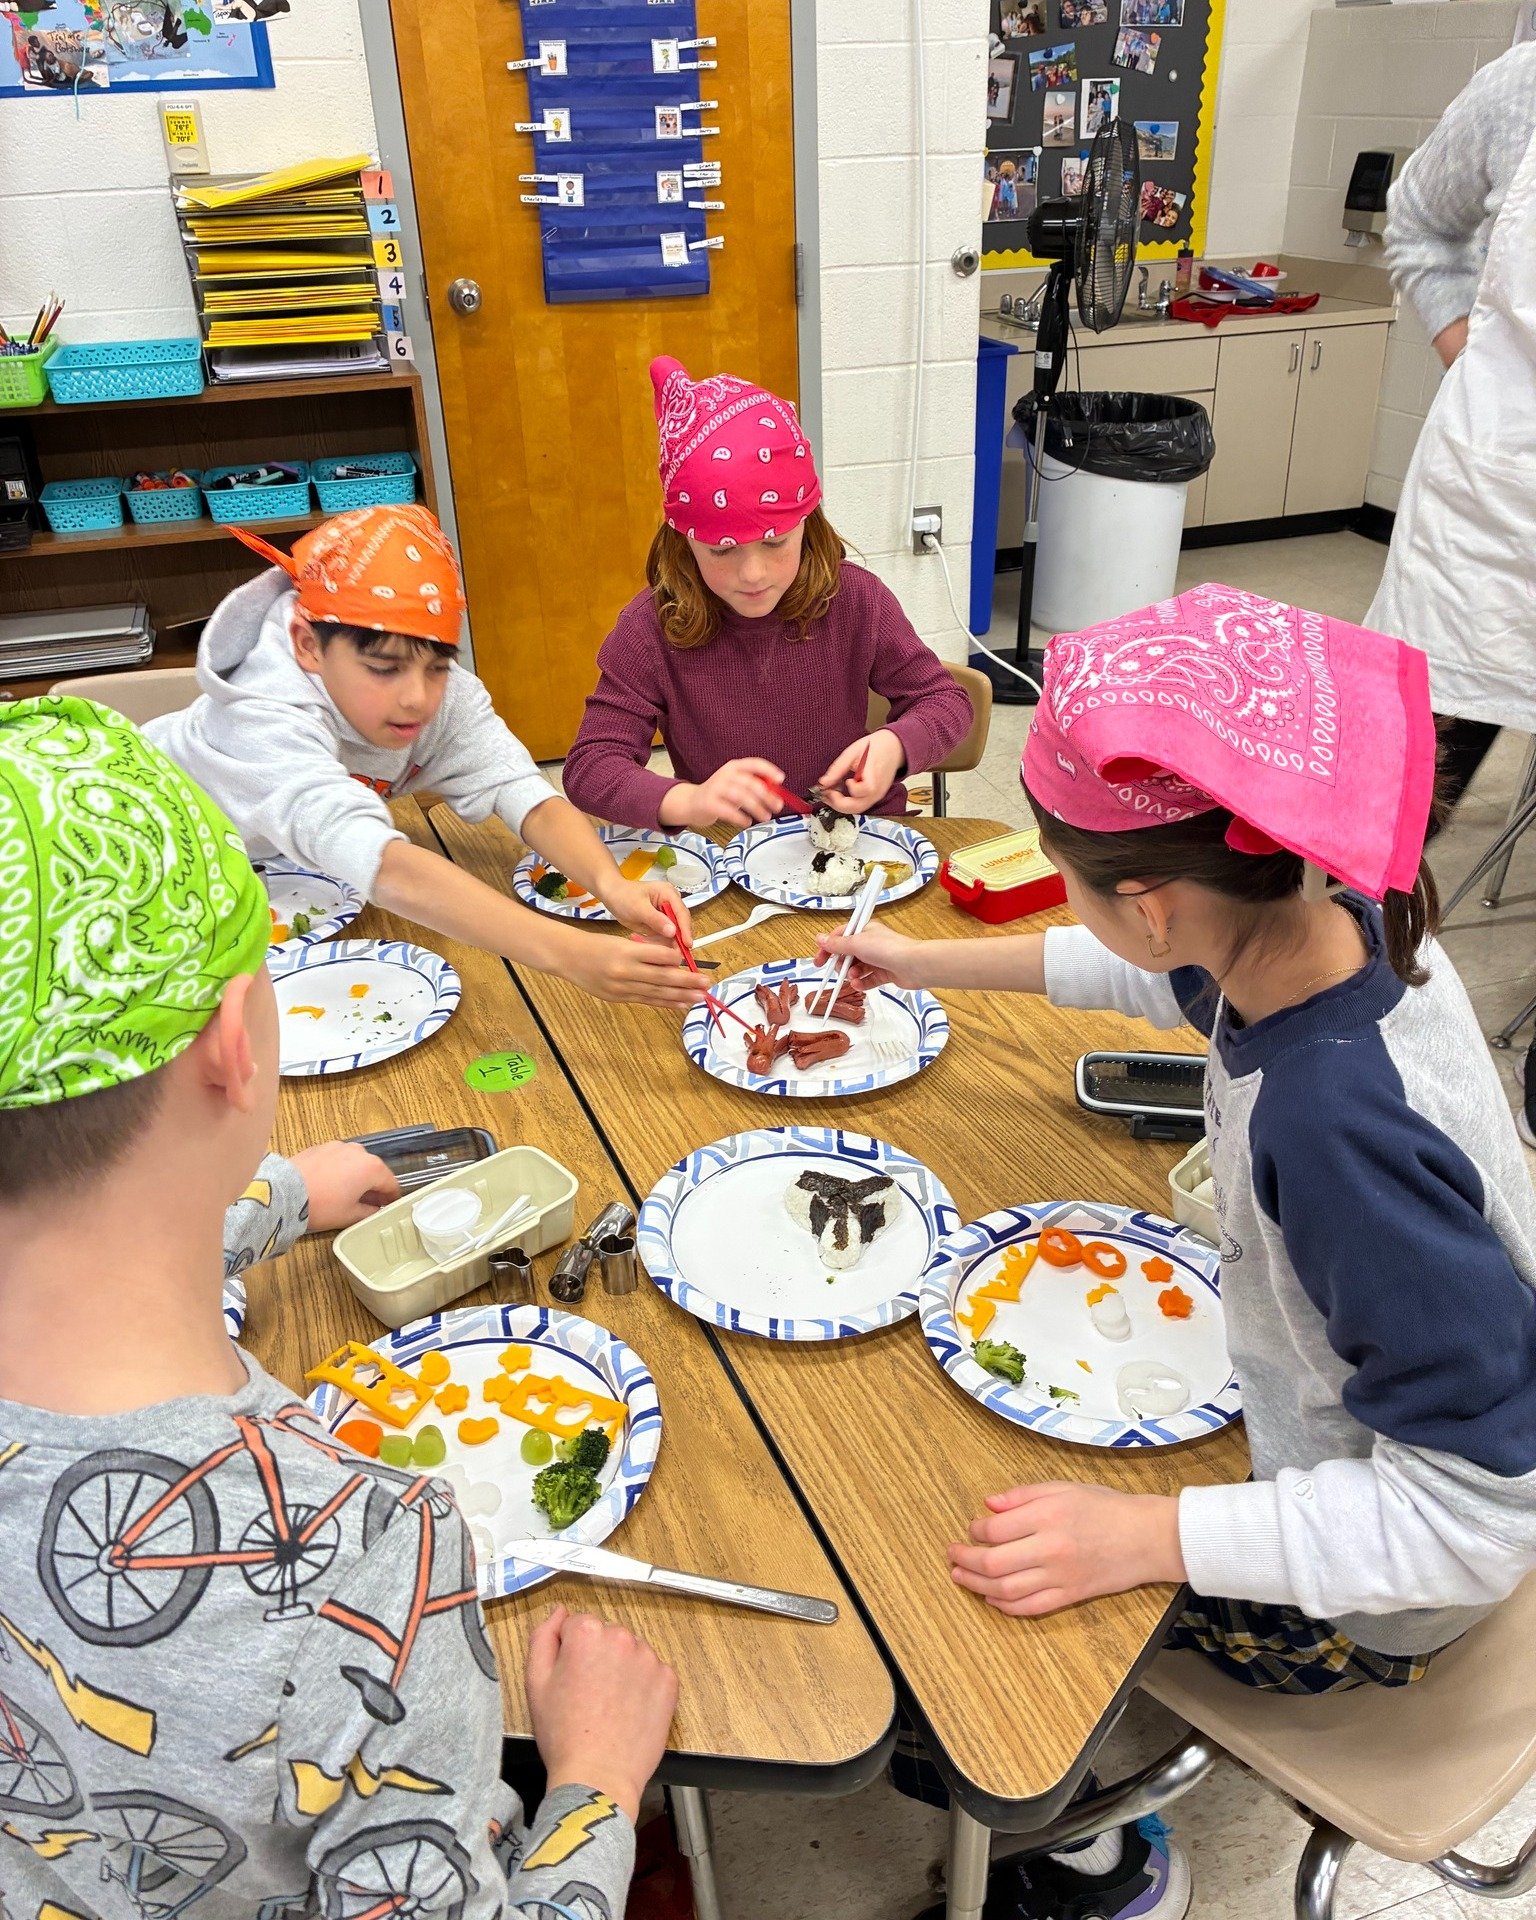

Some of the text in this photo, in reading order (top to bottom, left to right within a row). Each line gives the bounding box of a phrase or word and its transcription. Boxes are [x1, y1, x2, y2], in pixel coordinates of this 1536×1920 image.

[379, 175, 383, 195] 1
[381, 209, 396, 225] 2
[384, 243, 397, 263] 3
[389, 276, 403, 295] 4
[392, 310, 400, 327] 5
[395, 338, 407, 357] 6
[479, 1066, 502, 1078] 1
[505, 1054, 531, 1081] Table
